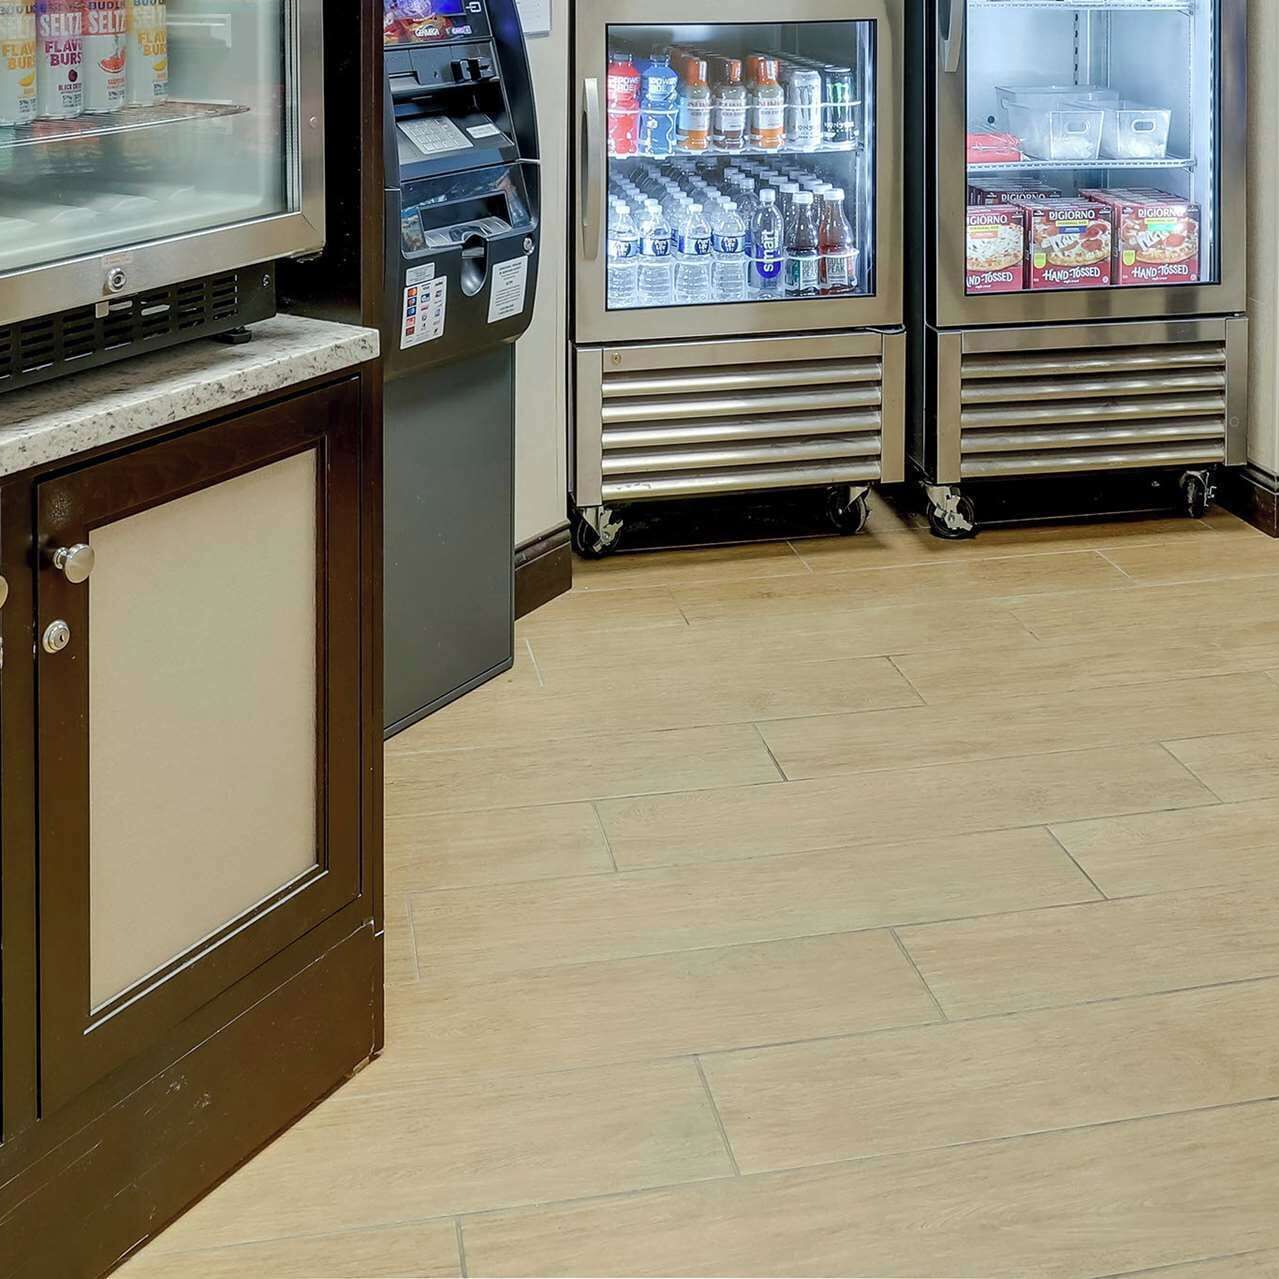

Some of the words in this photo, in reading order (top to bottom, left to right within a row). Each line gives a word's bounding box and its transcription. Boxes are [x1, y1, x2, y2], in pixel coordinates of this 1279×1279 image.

[45, 40, 82, 53] FLAV
[50, 53, 82, 67] BURS
[1001, 193, 1046, 201] DIGIORNO
[1049, 210, 1095, 220] DIGIORNO
[1138, 208, 1186, 218] DIGIORNO
[967, 215, 1008, 225] IGIORNO
[1042, 266, 1100, 281] HAND-TOSSED
[1131, 264, 1189, 278] HAND-TOSSED
[967, 272, 1014, 285] ND-TOSSED
